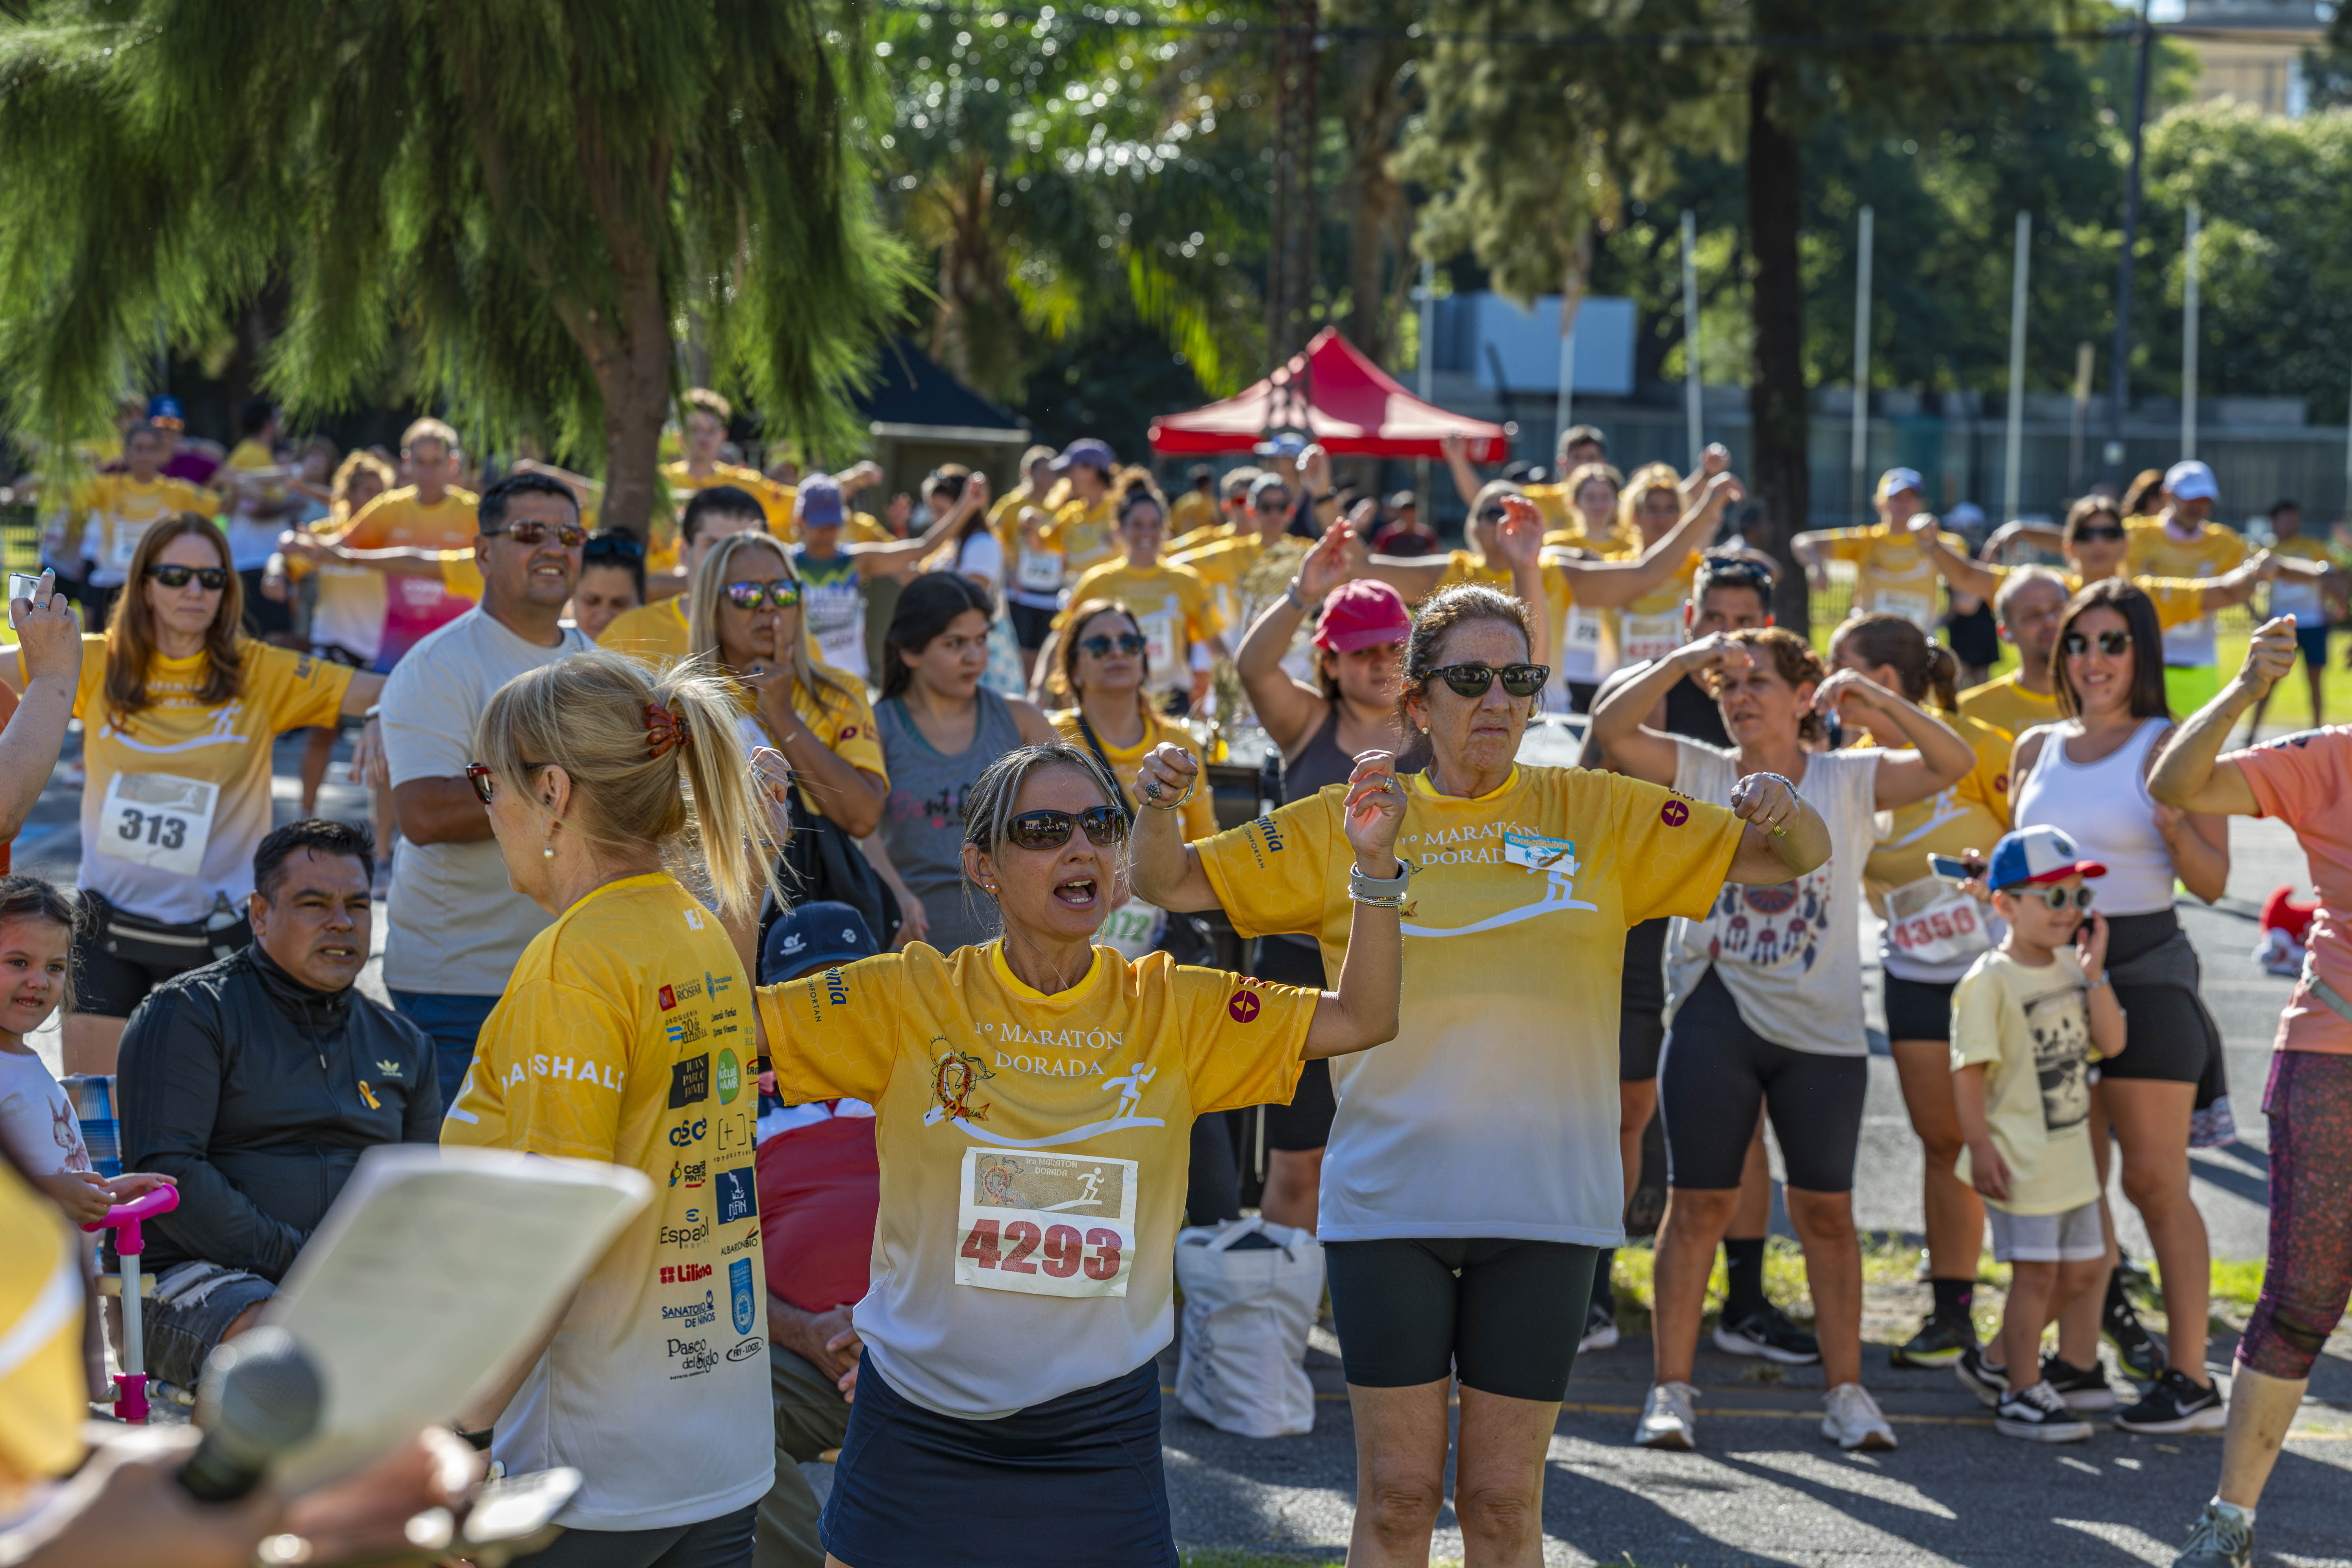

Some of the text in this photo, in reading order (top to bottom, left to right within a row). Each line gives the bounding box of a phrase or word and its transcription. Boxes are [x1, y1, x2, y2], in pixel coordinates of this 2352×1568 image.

[119, 808, 188, 849] 313
[1424, 821, 1540, 846] MARATÓN
[1509, 835, 1569, 850] COORDINADOR
[1421, 848, 1506, 865] DORAD
[676, 983, 702, 1002] ROSFAR
[682, 1019, 693, 1033] 20
[1000, 1023, 1123, 1050] MARATÓN
[994, 1050, 1105, 1077] DORADA
[722, 1078, 738, 1090] AMR
[960, 1107, 982, 1118] Vidas
[1035, 1167, 1067, 1177] DORADA
[1039, 1158, 1078, 1168] MARATON
[660, 1216, 709, 1249] Espaol
[961, 1218, 1123, 1281] 4293
[685, 1318, 696, 1328] DE
[667, 1338, 706, 1357] Paseo
[682, 1348, 719, 1373] del Siglo
